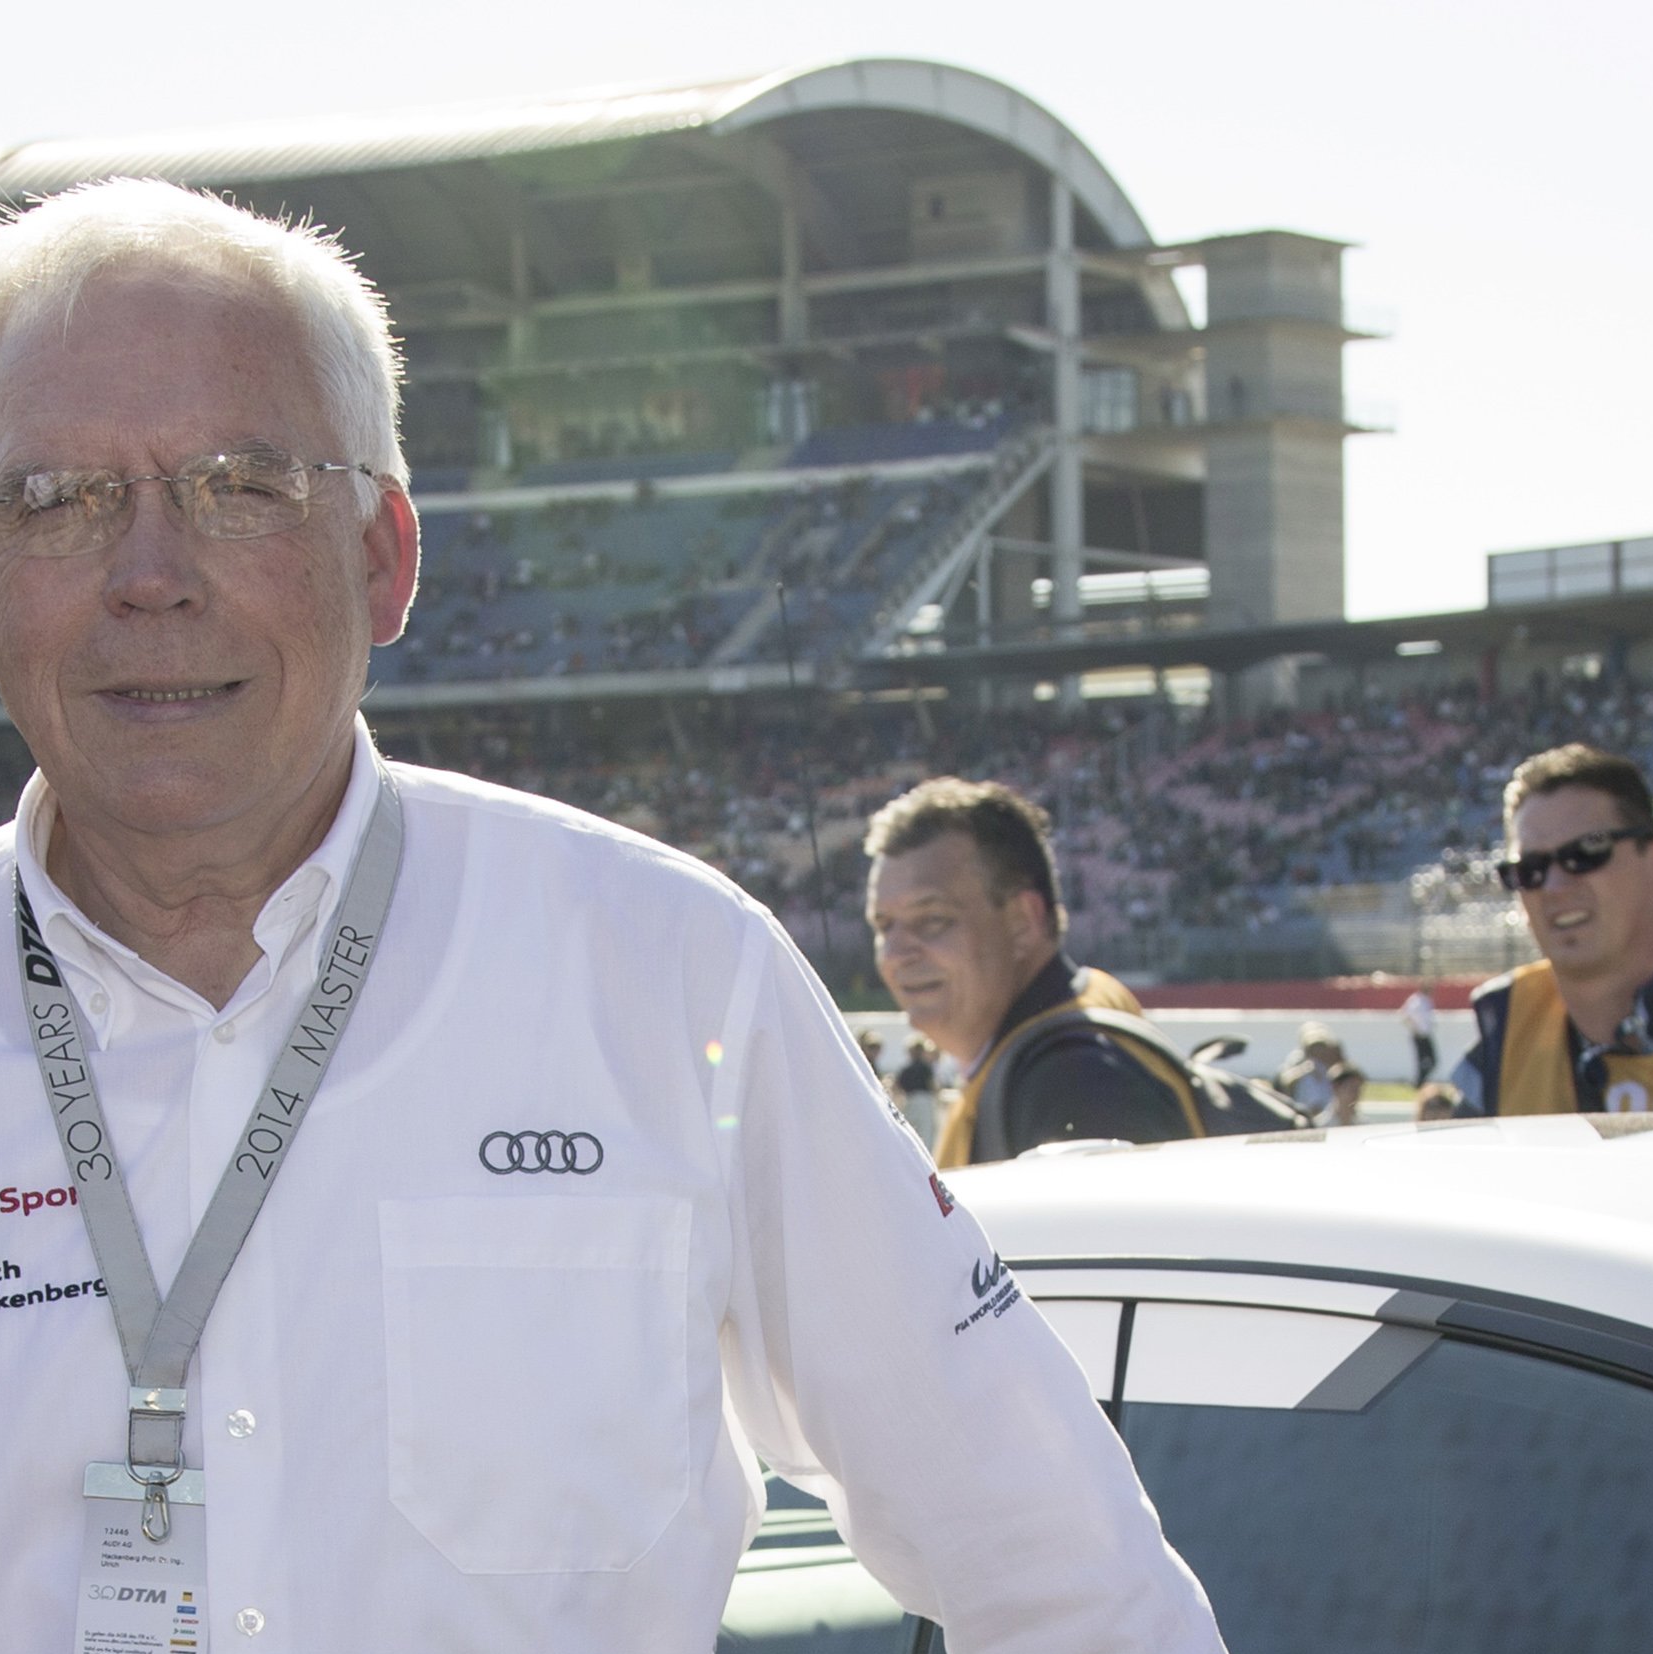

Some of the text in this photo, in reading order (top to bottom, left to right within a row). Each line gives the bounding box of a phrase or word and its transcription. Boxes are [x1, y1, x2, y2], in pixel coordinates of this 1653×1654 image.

[33, 1003, 91, 1115] YEARS
[236, 924, 374, 1180] 2014 MASTER
[67, 1120, 112, 1182] 30
